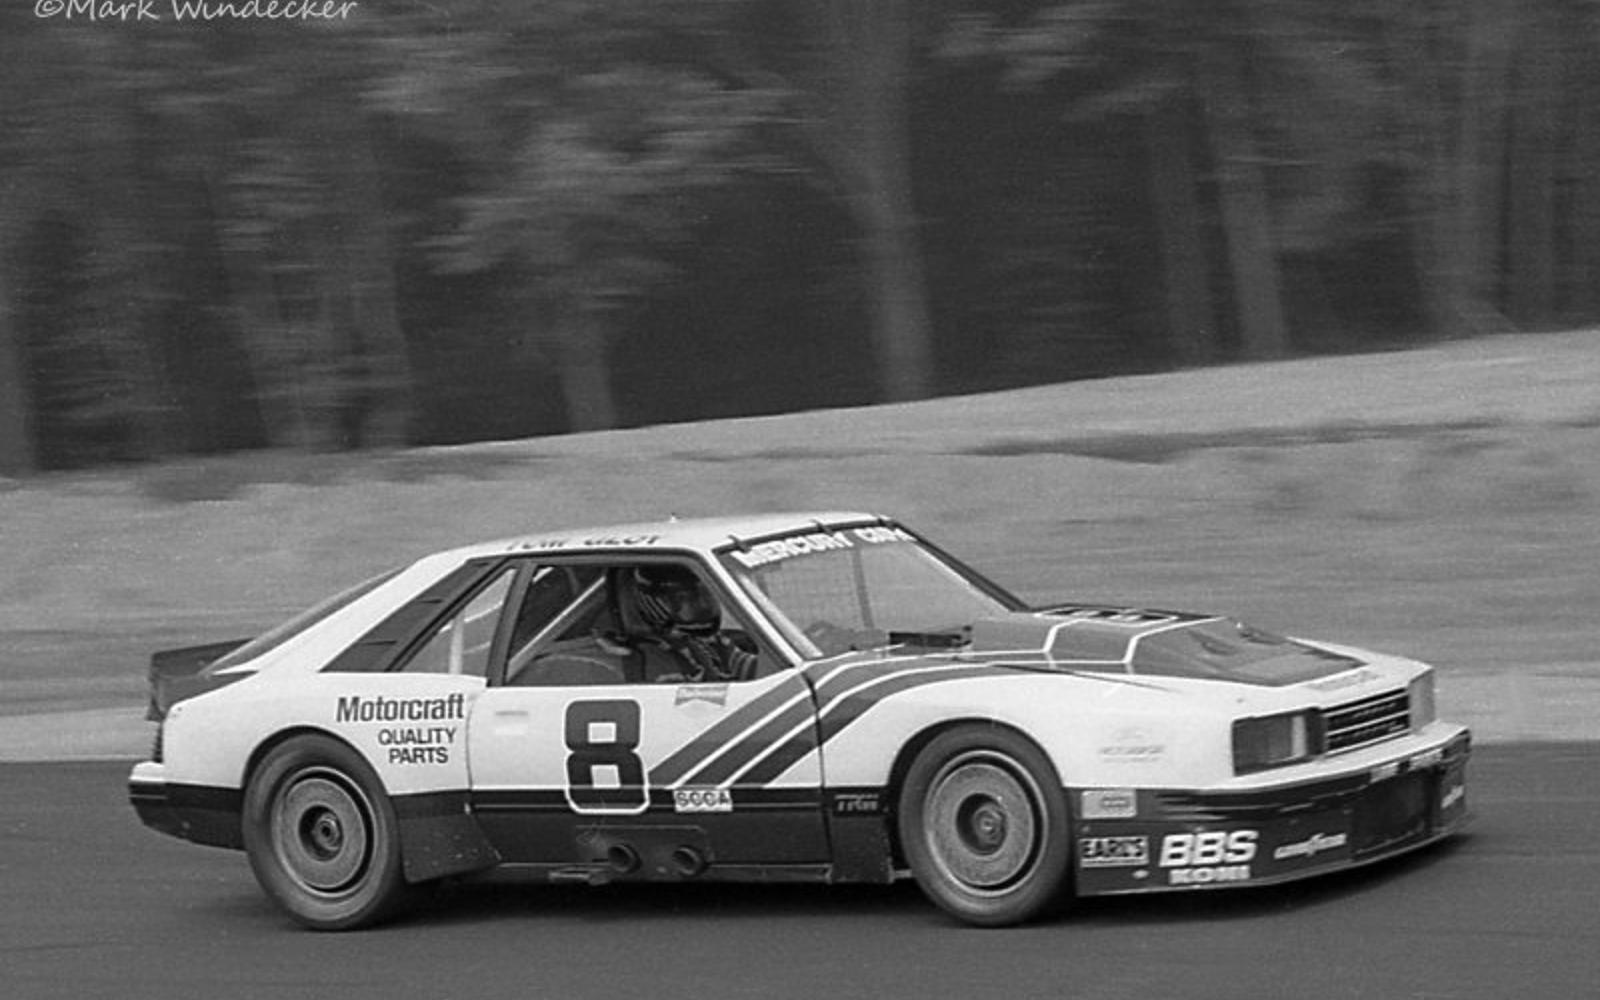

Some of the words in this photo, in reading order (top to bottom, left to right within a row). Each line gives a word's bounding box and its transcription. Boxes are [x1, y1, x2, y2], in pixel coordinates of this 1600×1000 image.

[336, 693, 464, 722] Motorcraft
[378, 728, 456, 745] QUALITY
[388, 746, 449, 763] PARTS
[564, 699, 650, 814] 8
[1159, 831, 1259, 867] BBS
